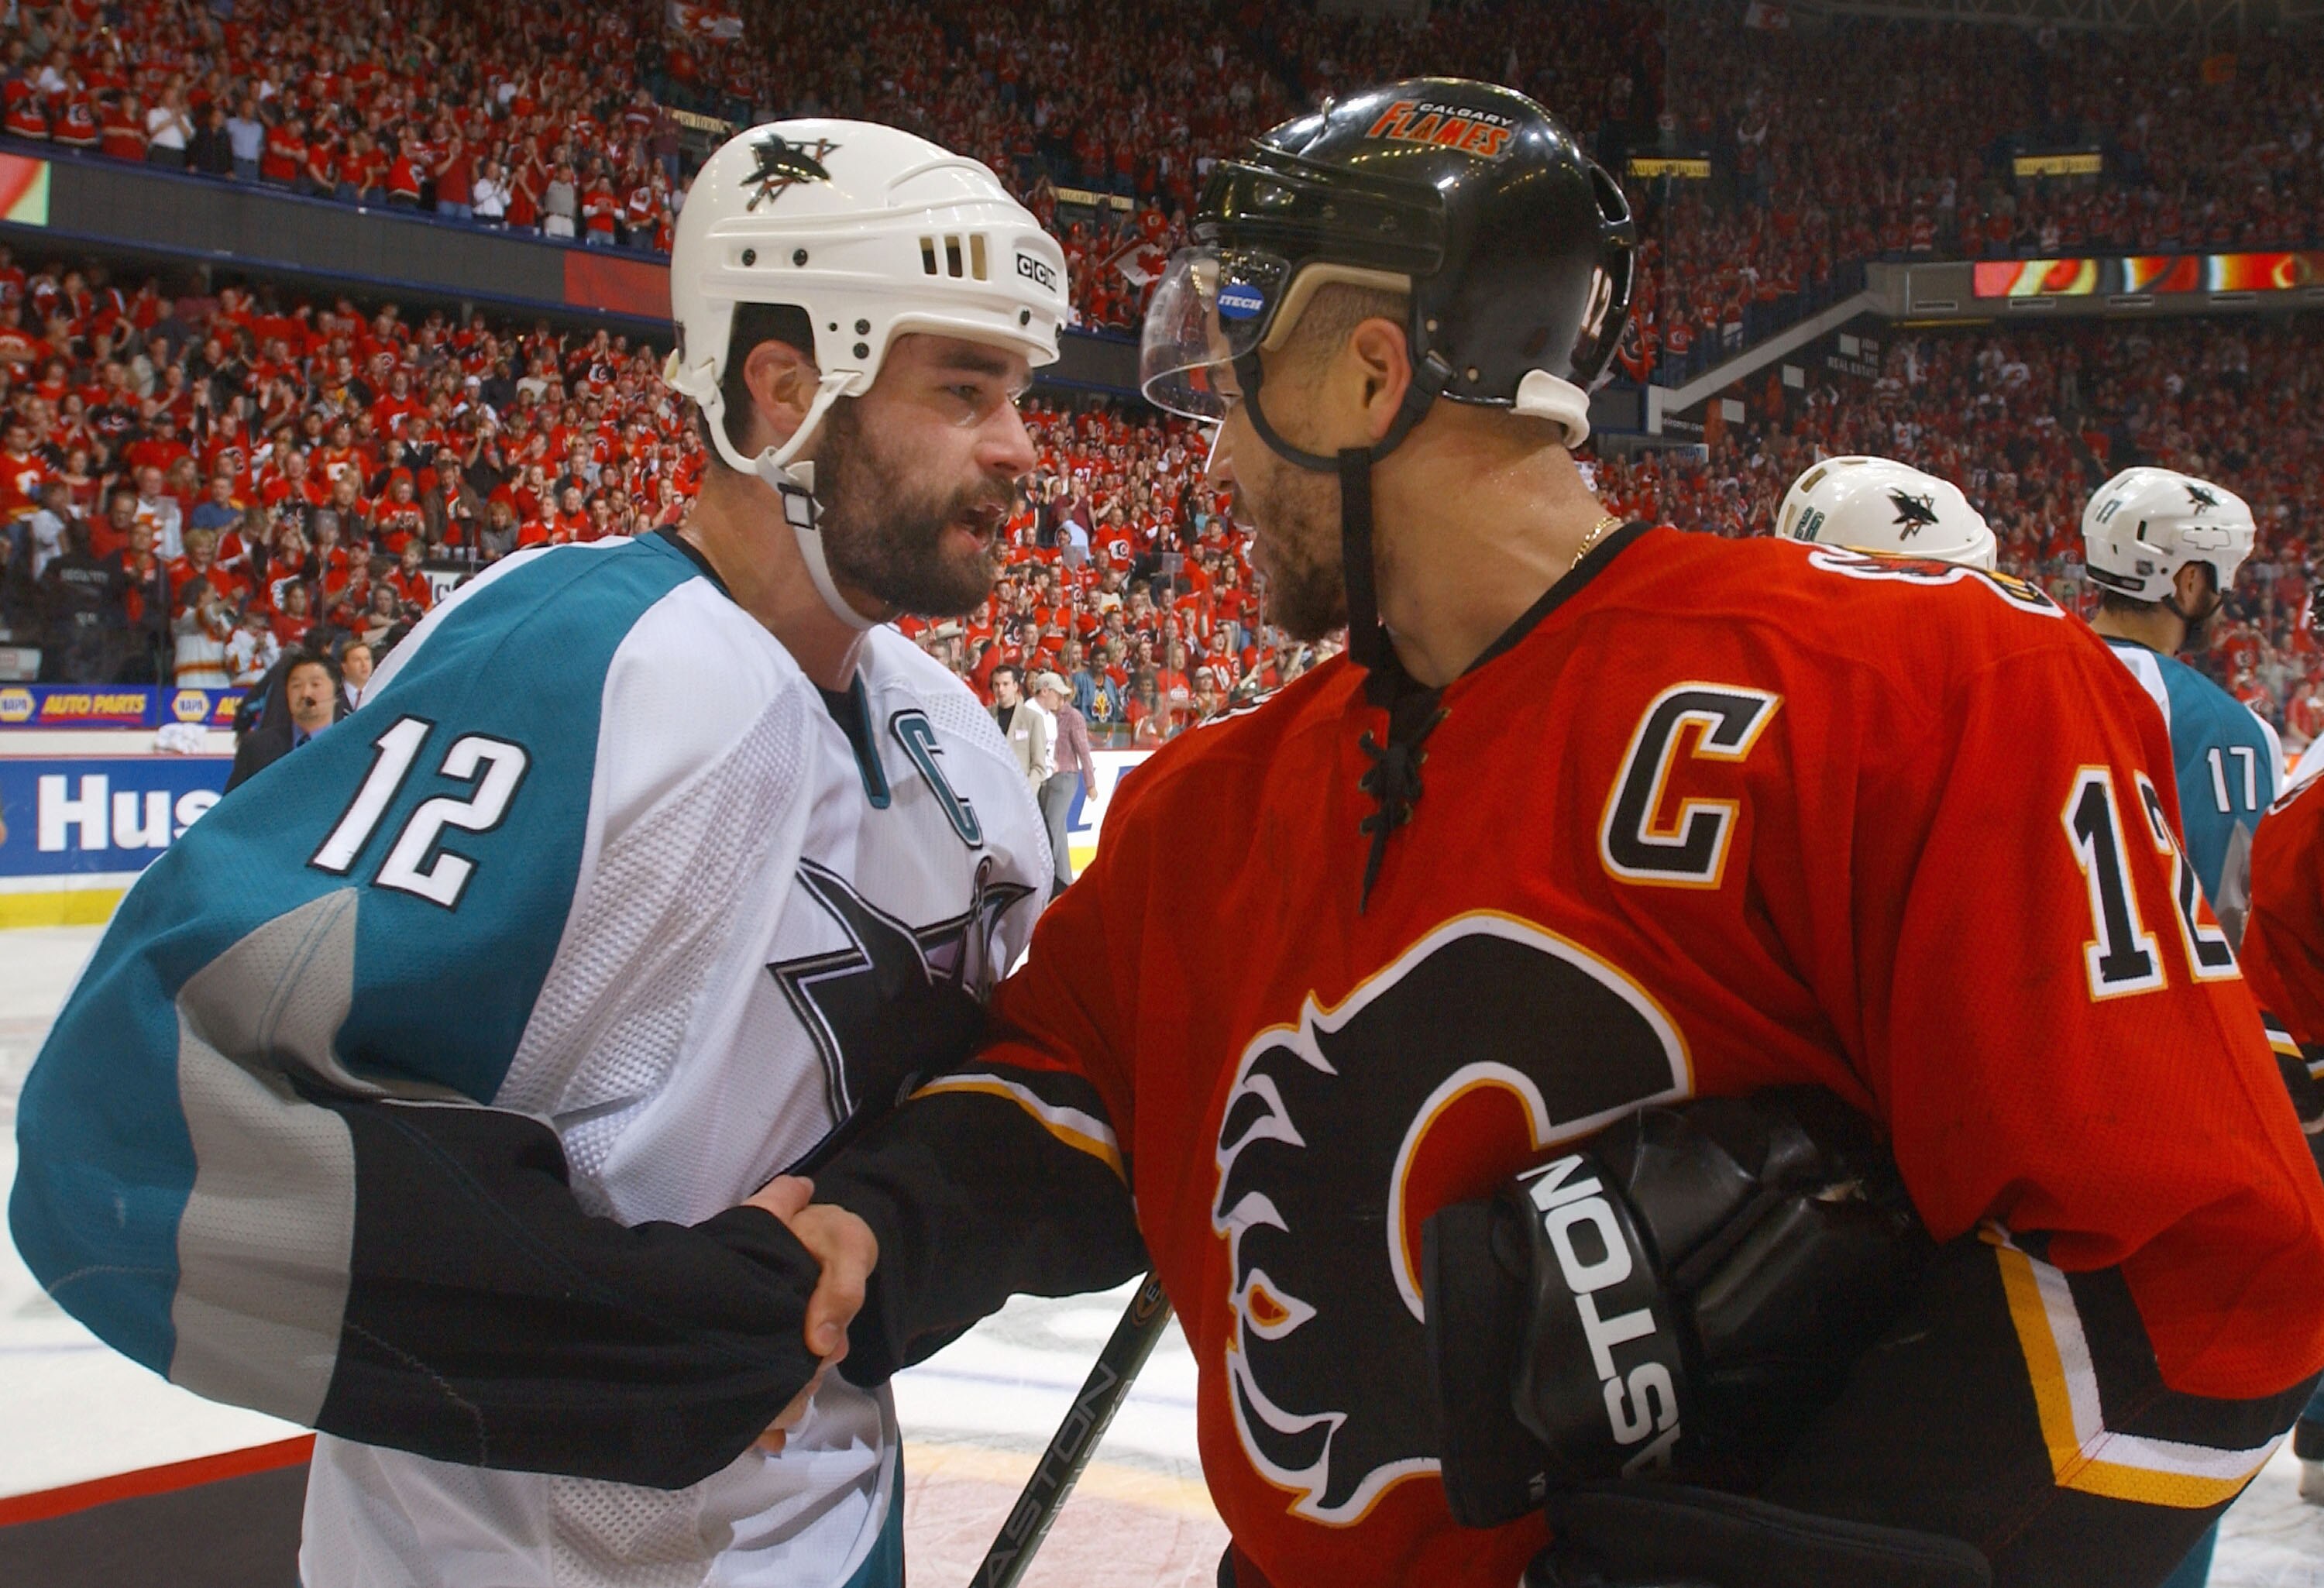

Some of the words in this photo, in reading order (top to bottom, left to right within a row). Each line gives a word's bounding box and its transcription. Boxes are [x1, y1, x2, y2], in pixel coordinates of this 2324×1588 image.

[1365, 99, 1510, 158] FLAMES
[1419, 102, 1514, 127] CALGARY
[1218, 295, 1263, 310] ITECH
[1582, 266, 1612, 339] 12
[41, 694, 92, 714] AUTO
[92, 694, 147, 714] PARTS
[178, 699, 205, 711] NAPA
[306, 713, 534, 913] 12
[889, 708, 984, 850] C
[1597, 680, 1785, 890] C
[2207, 745, 2257, 813] 17
[2060, 763, 2244, 1003] 12
